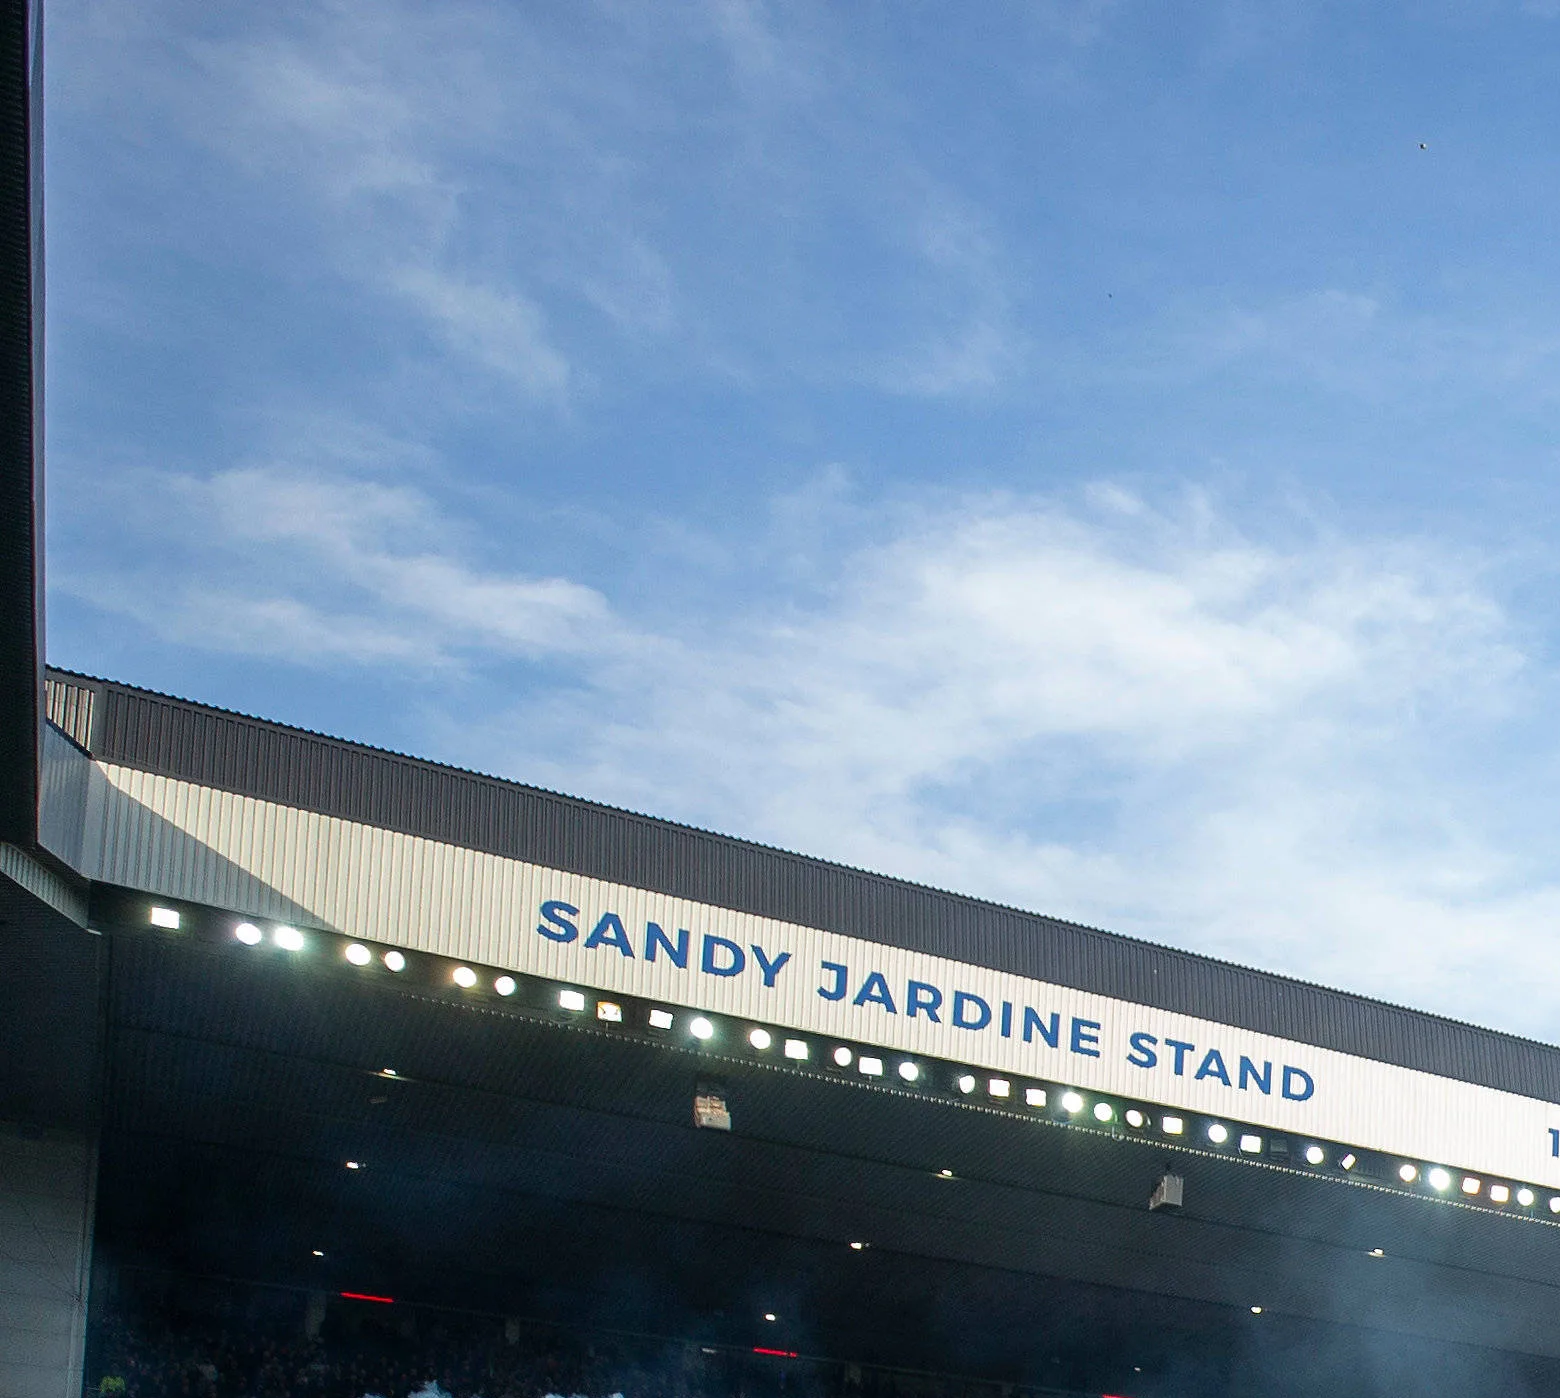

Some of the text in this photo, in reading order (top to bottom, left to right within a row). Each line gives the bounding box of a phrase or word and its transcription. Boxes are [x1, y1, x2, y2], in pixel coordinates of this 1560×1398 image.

[535, 899, 1316, 1102] SANDY JARDINE STAND
